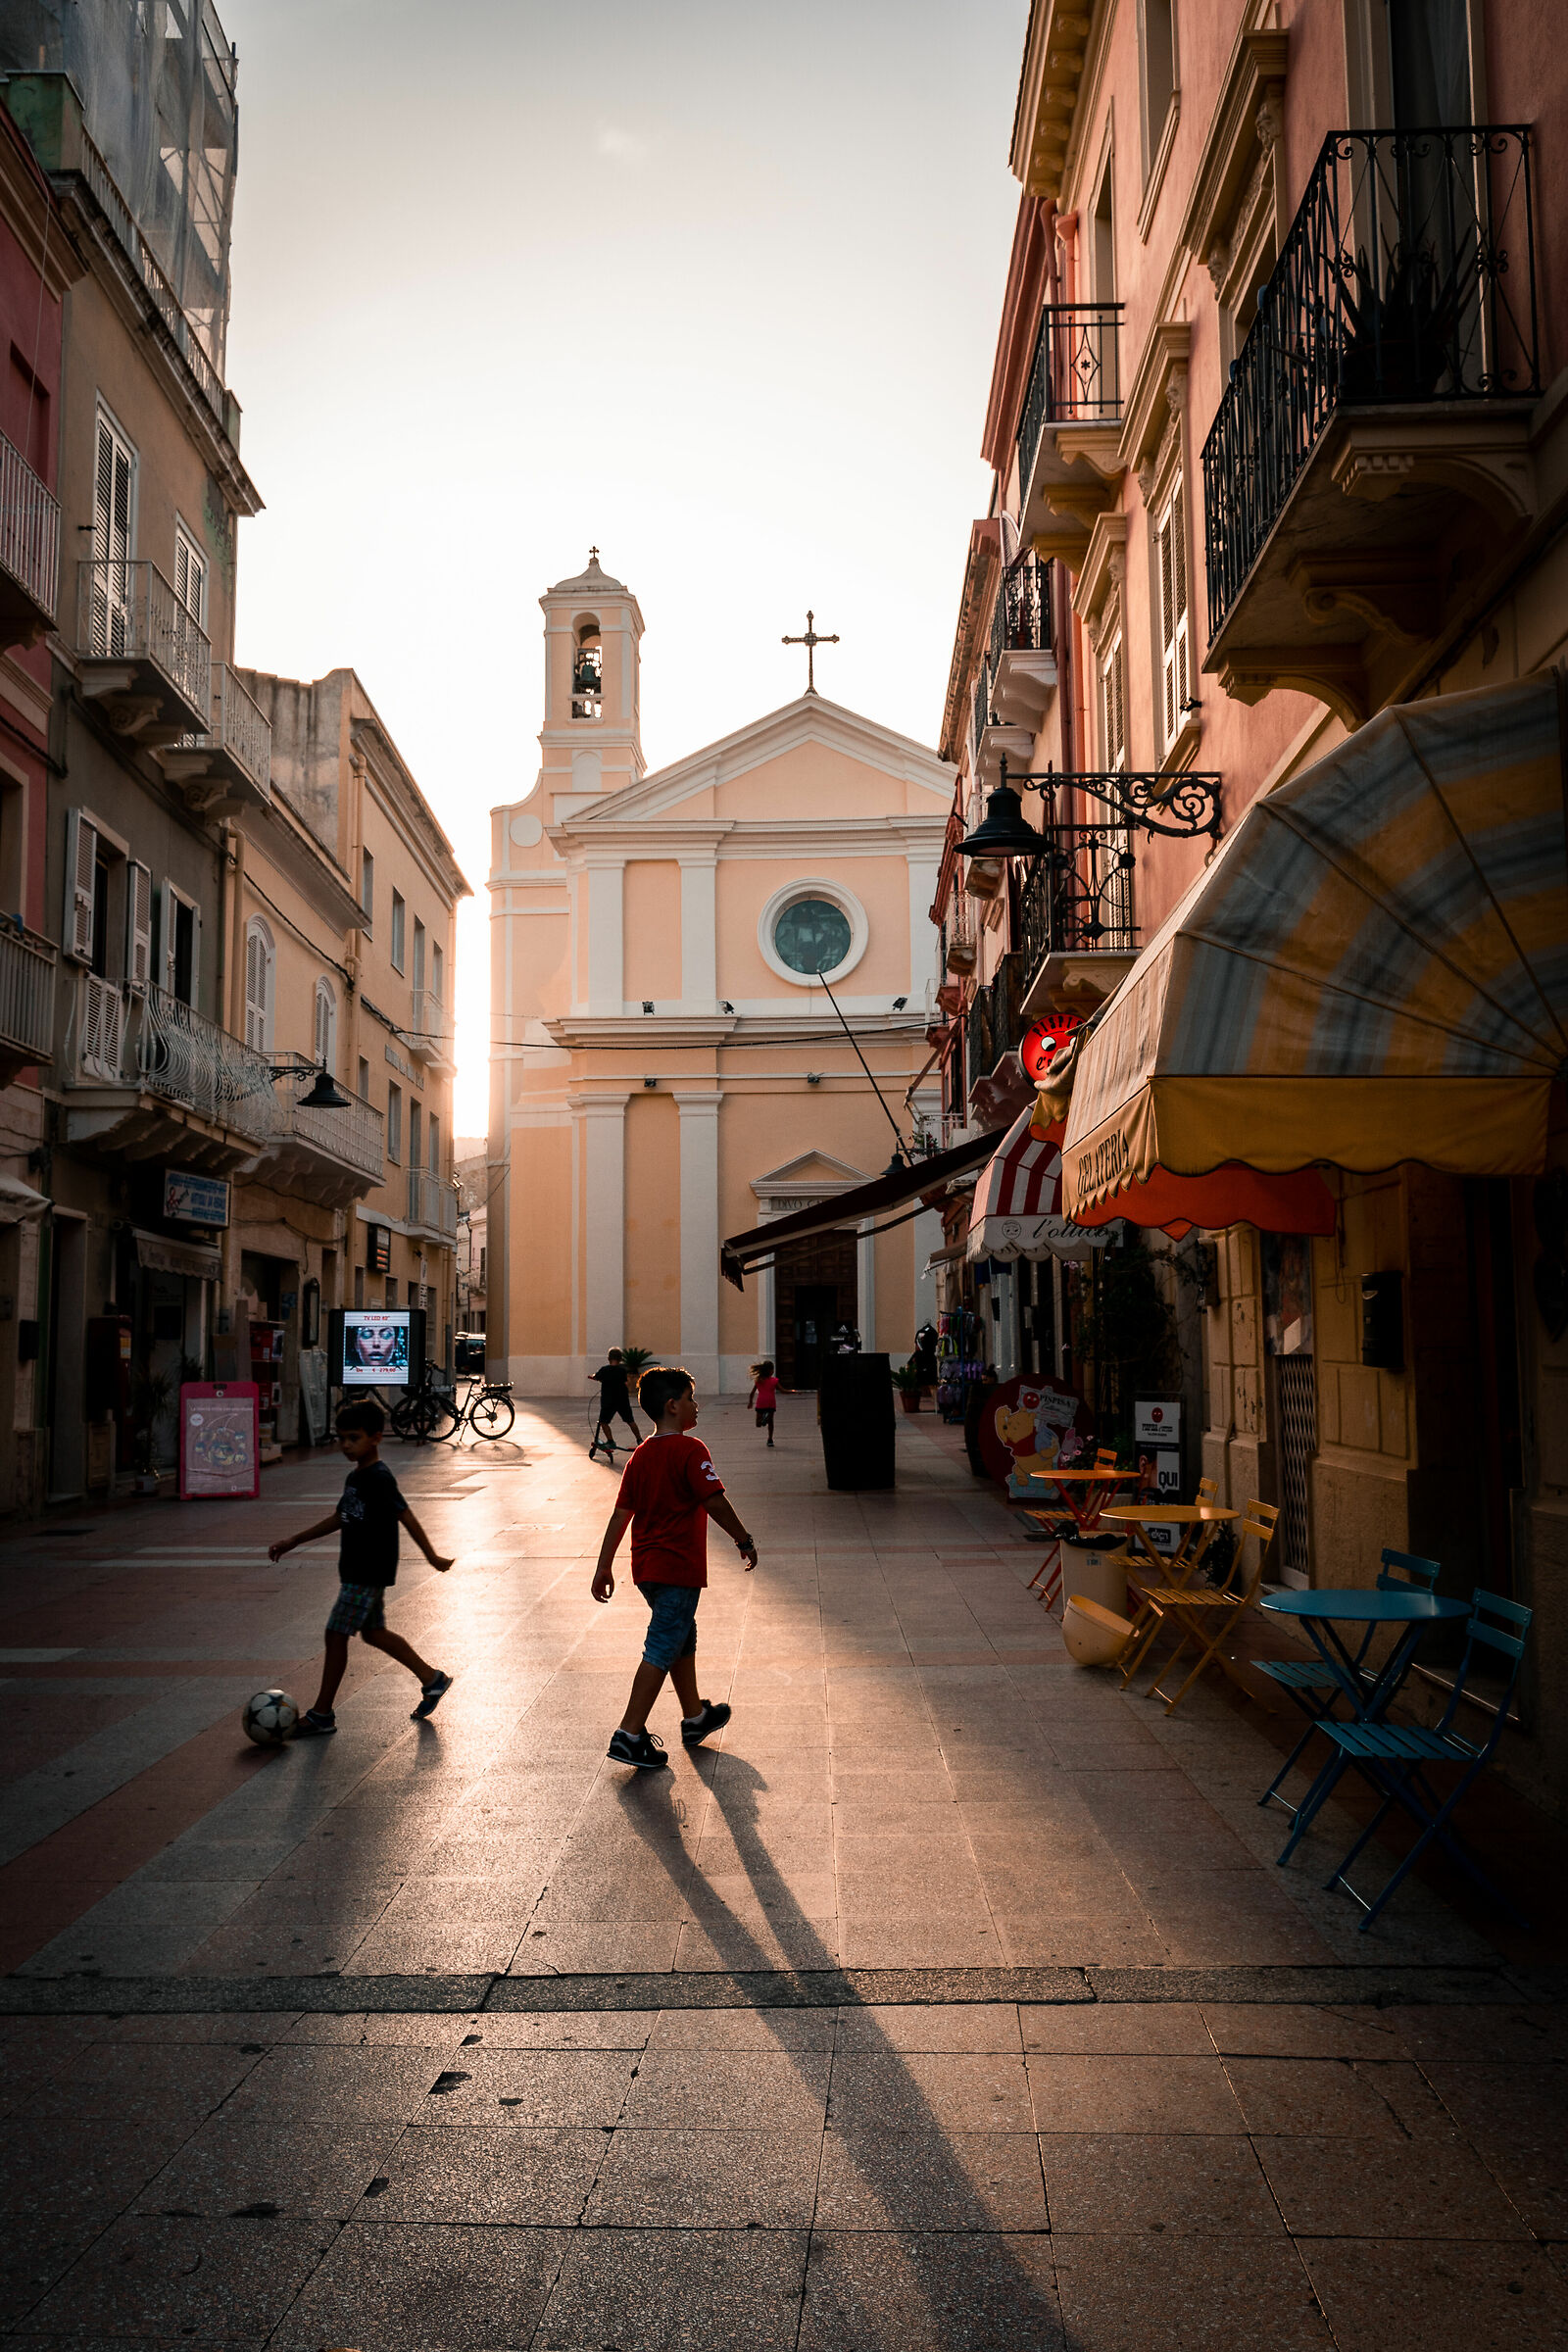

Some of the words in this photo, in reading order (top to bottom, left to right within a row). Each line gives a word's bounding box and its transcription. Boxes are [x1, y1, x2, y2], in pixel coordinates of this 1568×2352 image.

[1078, 1129, 1129, 1197] GELATERIA
[778, 1199, 803, 1209] DIVO
[1040, 1395, 1071, 1408] PISPISA
[700, 1460, 719, 1481] 3
[1159, 1471, 1177, 1489] QUI
